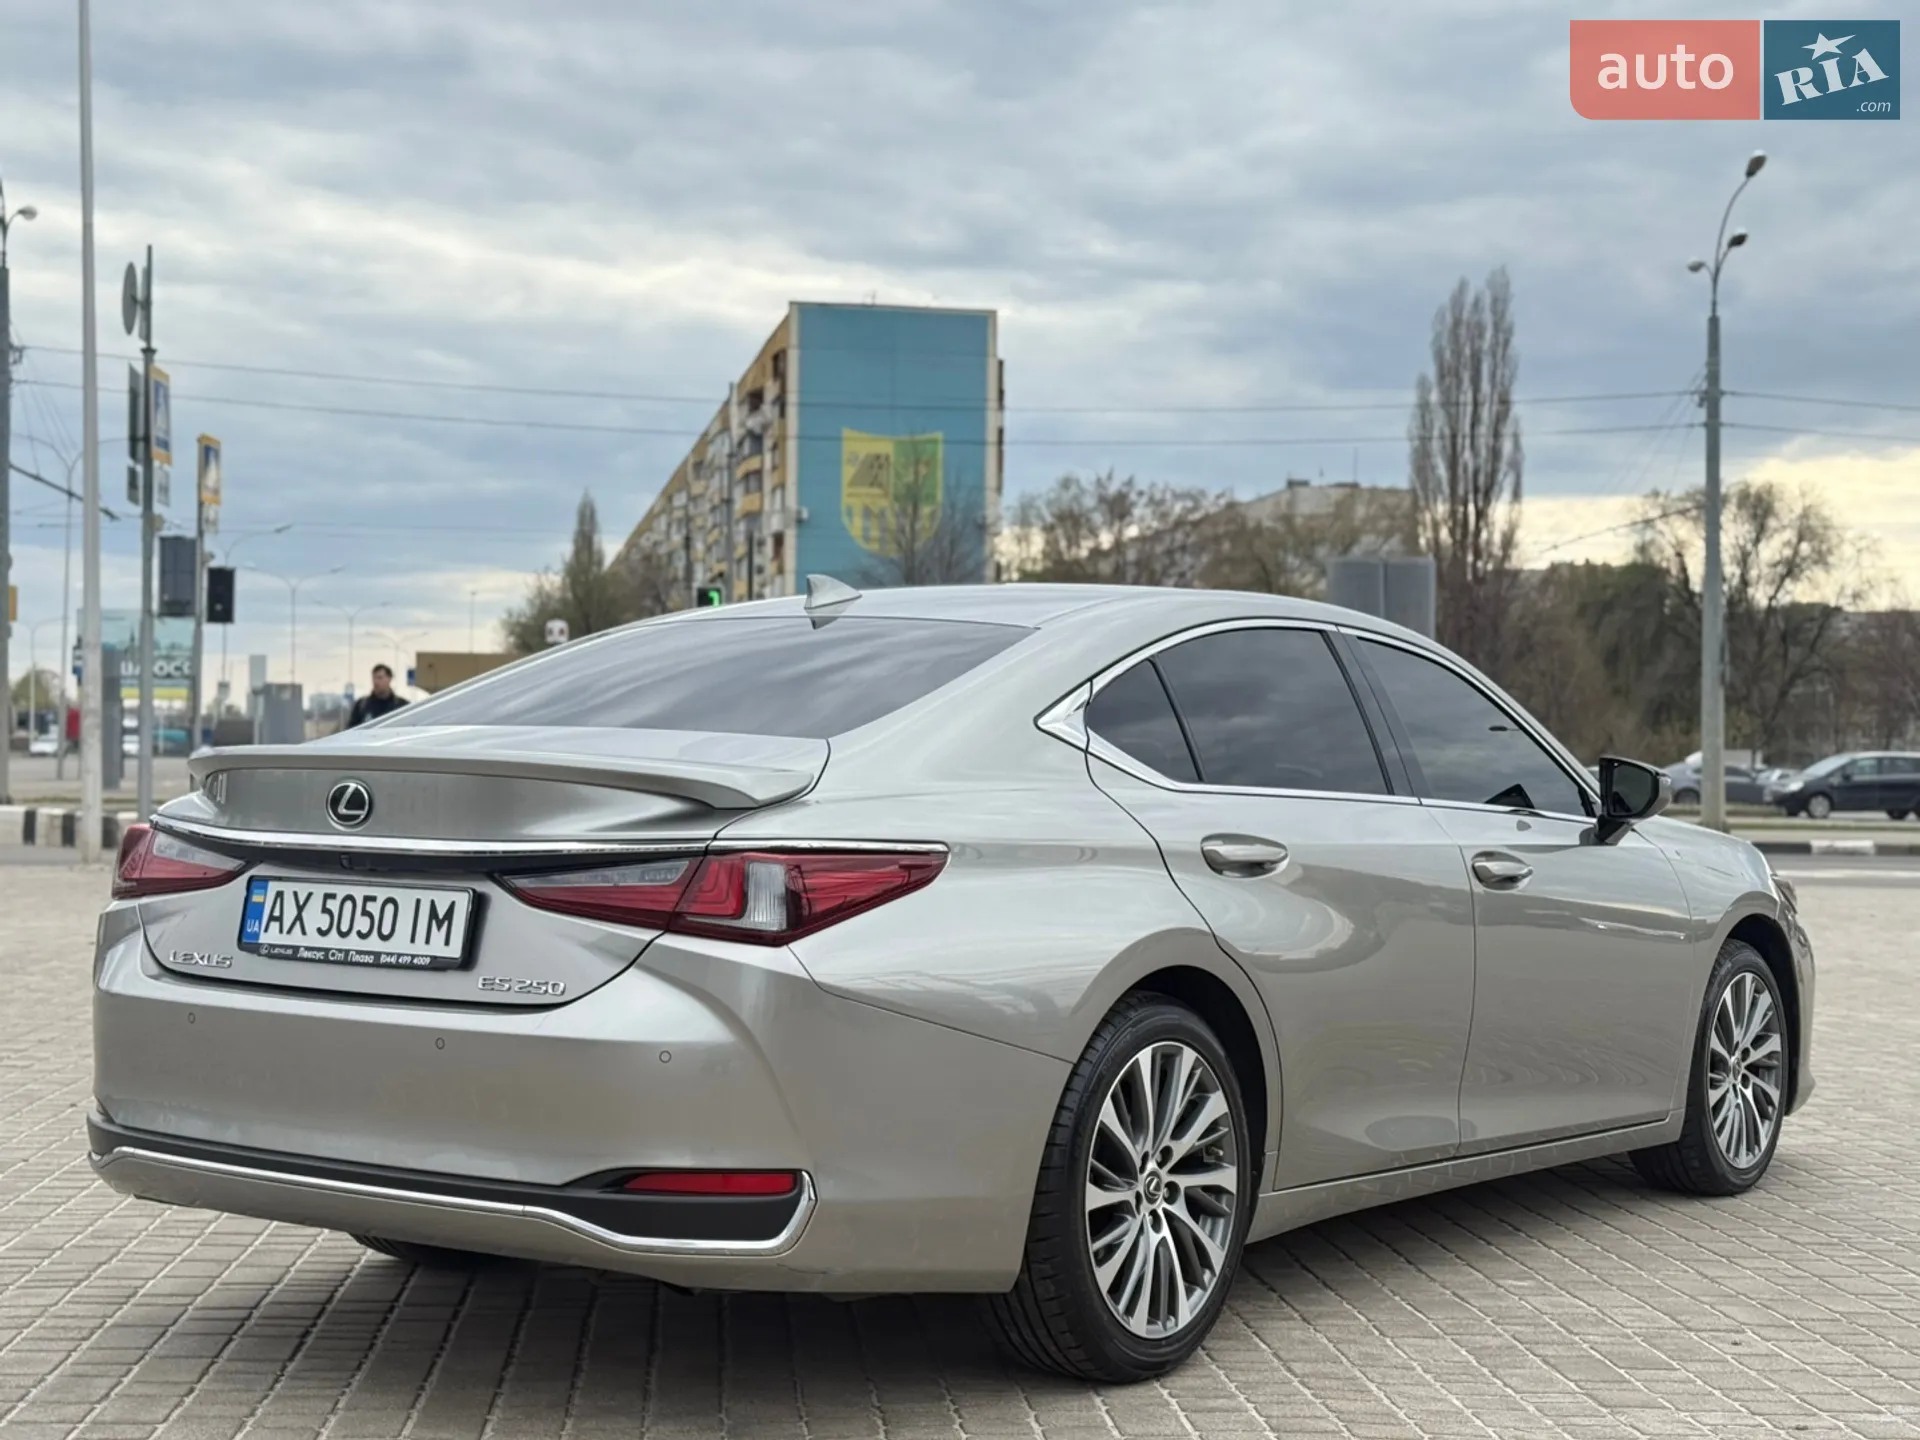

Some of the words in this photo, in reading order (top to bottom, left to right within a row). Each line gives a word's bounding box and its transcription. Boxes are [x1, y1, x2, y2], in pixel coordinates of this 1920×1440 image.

[246, 919, 260, 933] UA
[263, 890, 314, 936] AX
[316, 892, 399, 942] 5050
[410, 898, 456, 947] IM
[169, 949, 234, 969] LEXUS
[478, 975, 512, 992] ES
[514, 978, 566, 996] 250
